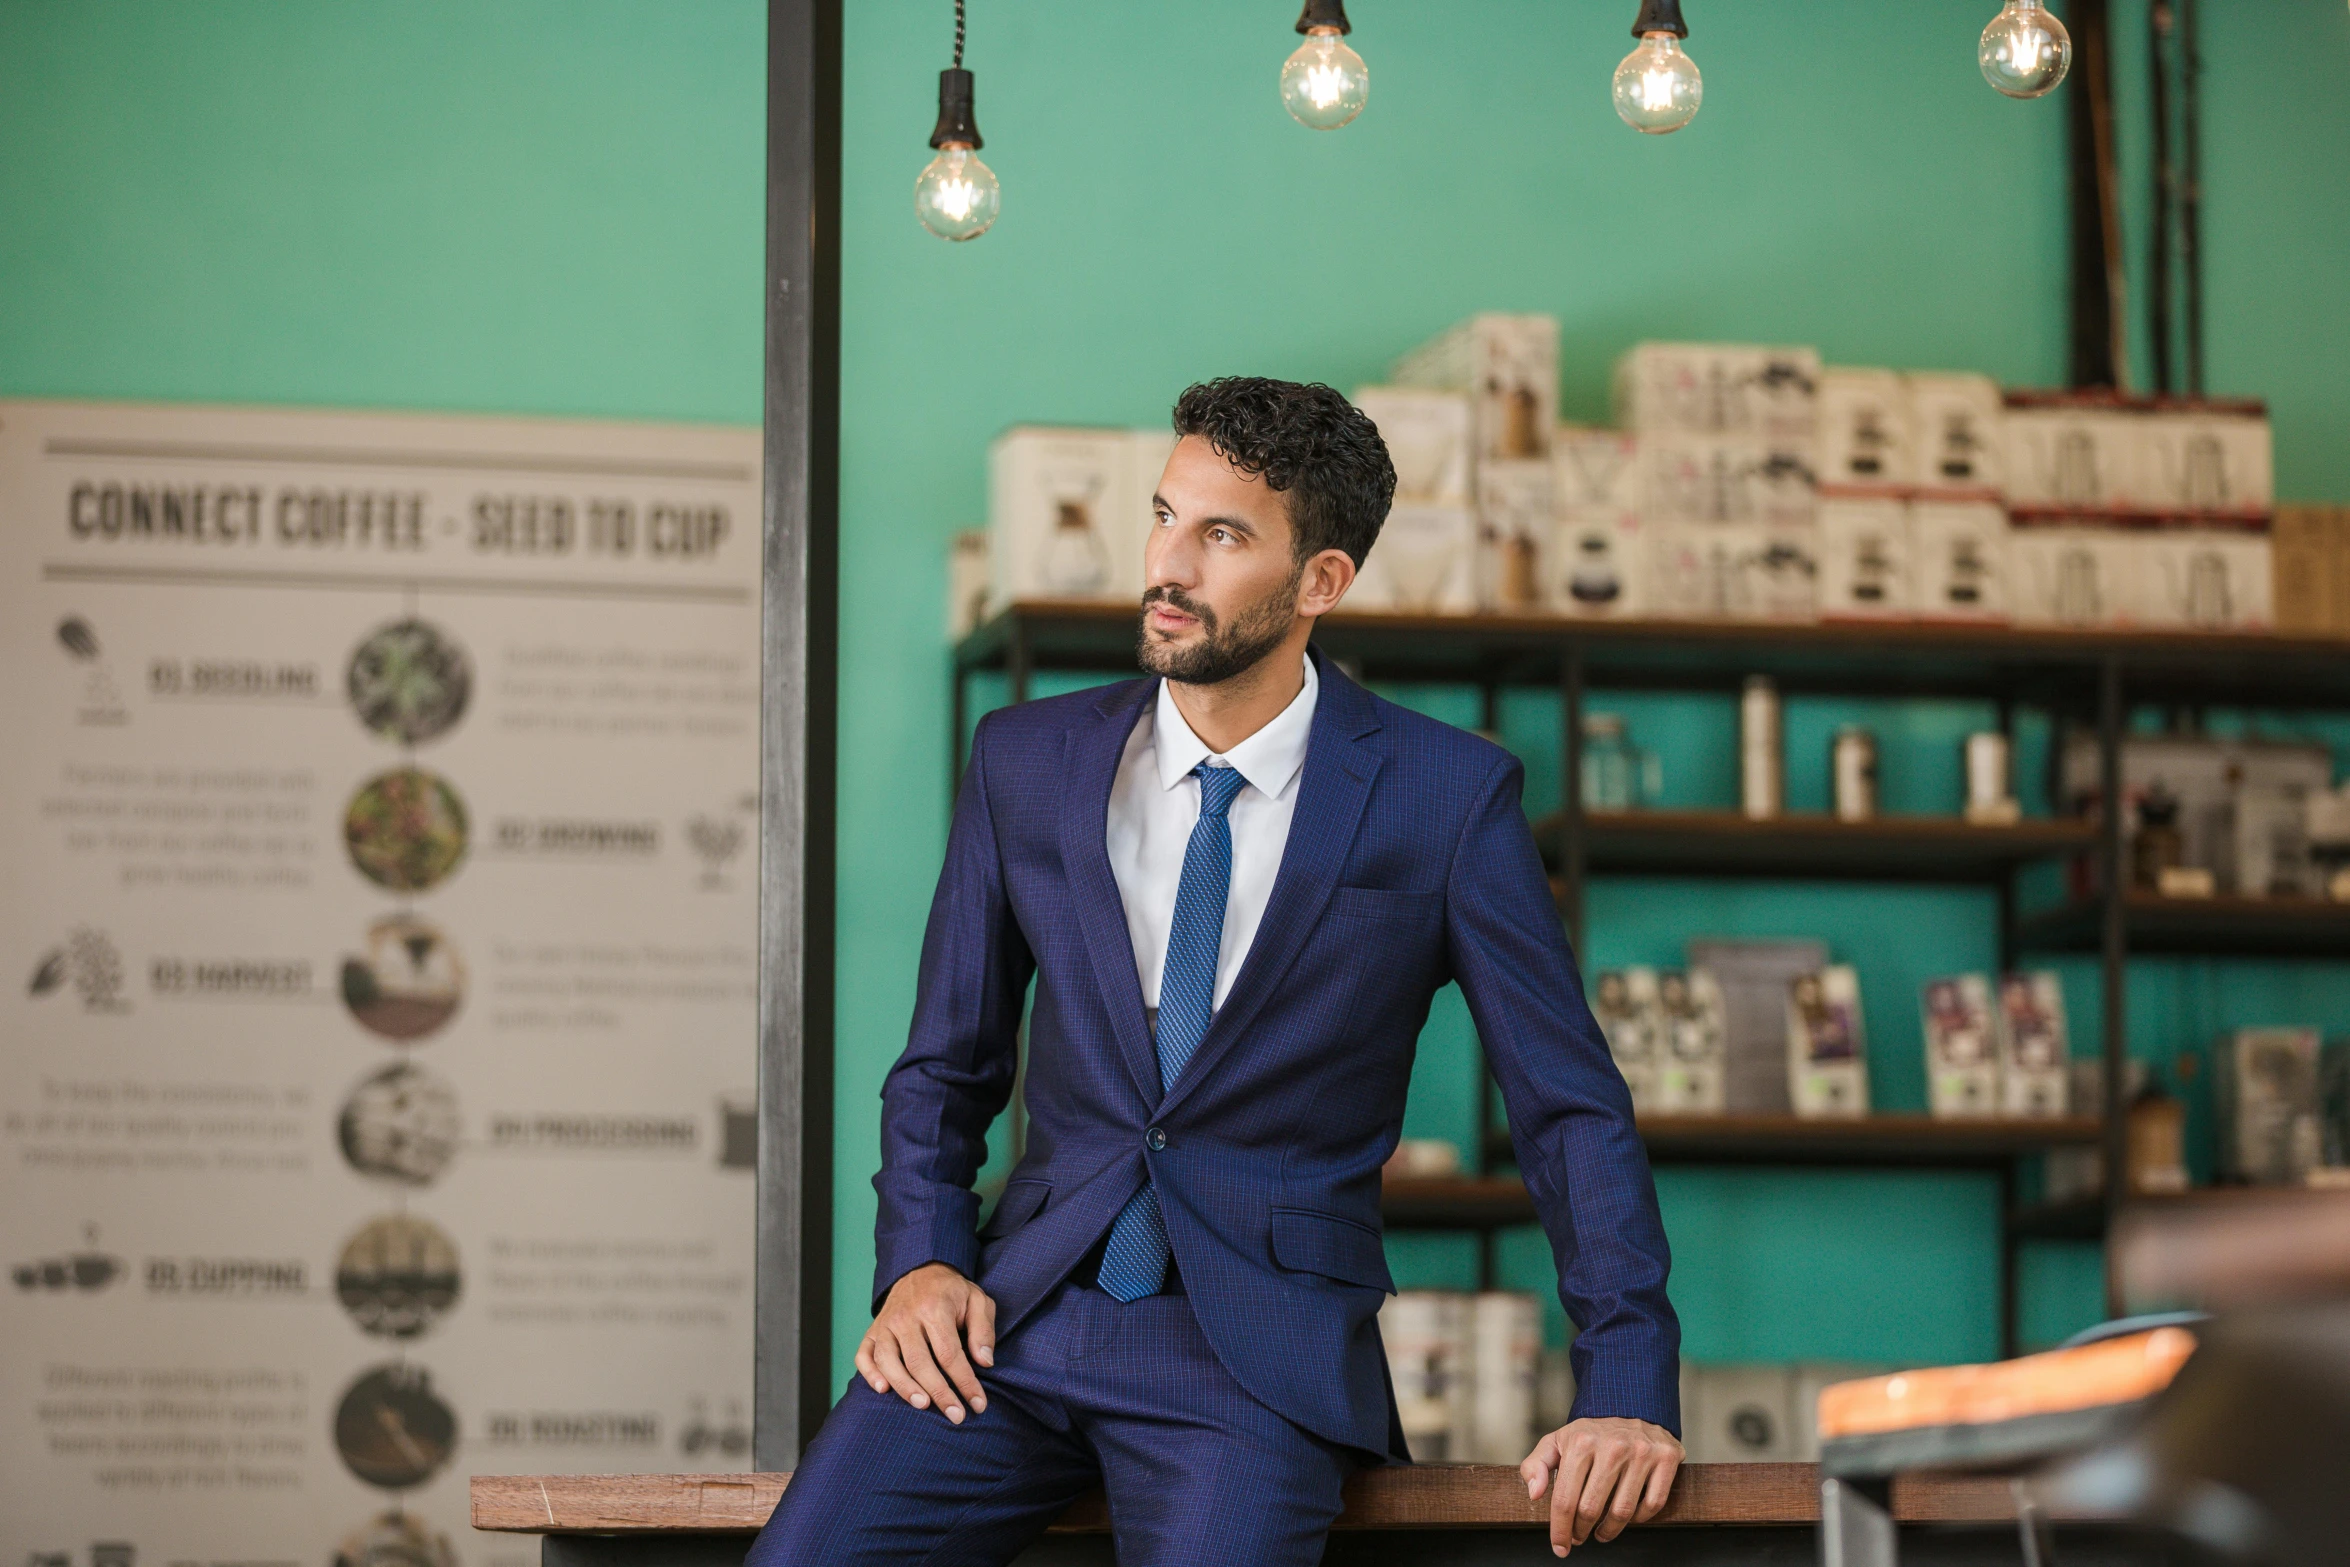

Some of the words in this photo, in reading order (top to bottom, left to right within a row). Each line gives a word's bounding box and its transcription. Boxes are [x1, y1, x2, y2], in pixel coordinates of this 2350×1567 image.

[68, 479, 264, 541] CONNECT
[275, 486, 428, 553] COFFEE
[470, 493, 574, 557] SEED
[585, 497, 637, 559] TO
[645, 499, 731, 561] CUP
[193, 957, 315, 997] HARVEST
[187, 1258, 310, 1295] CUPPING
[530, 1410, 664, 1449] ROASTING
